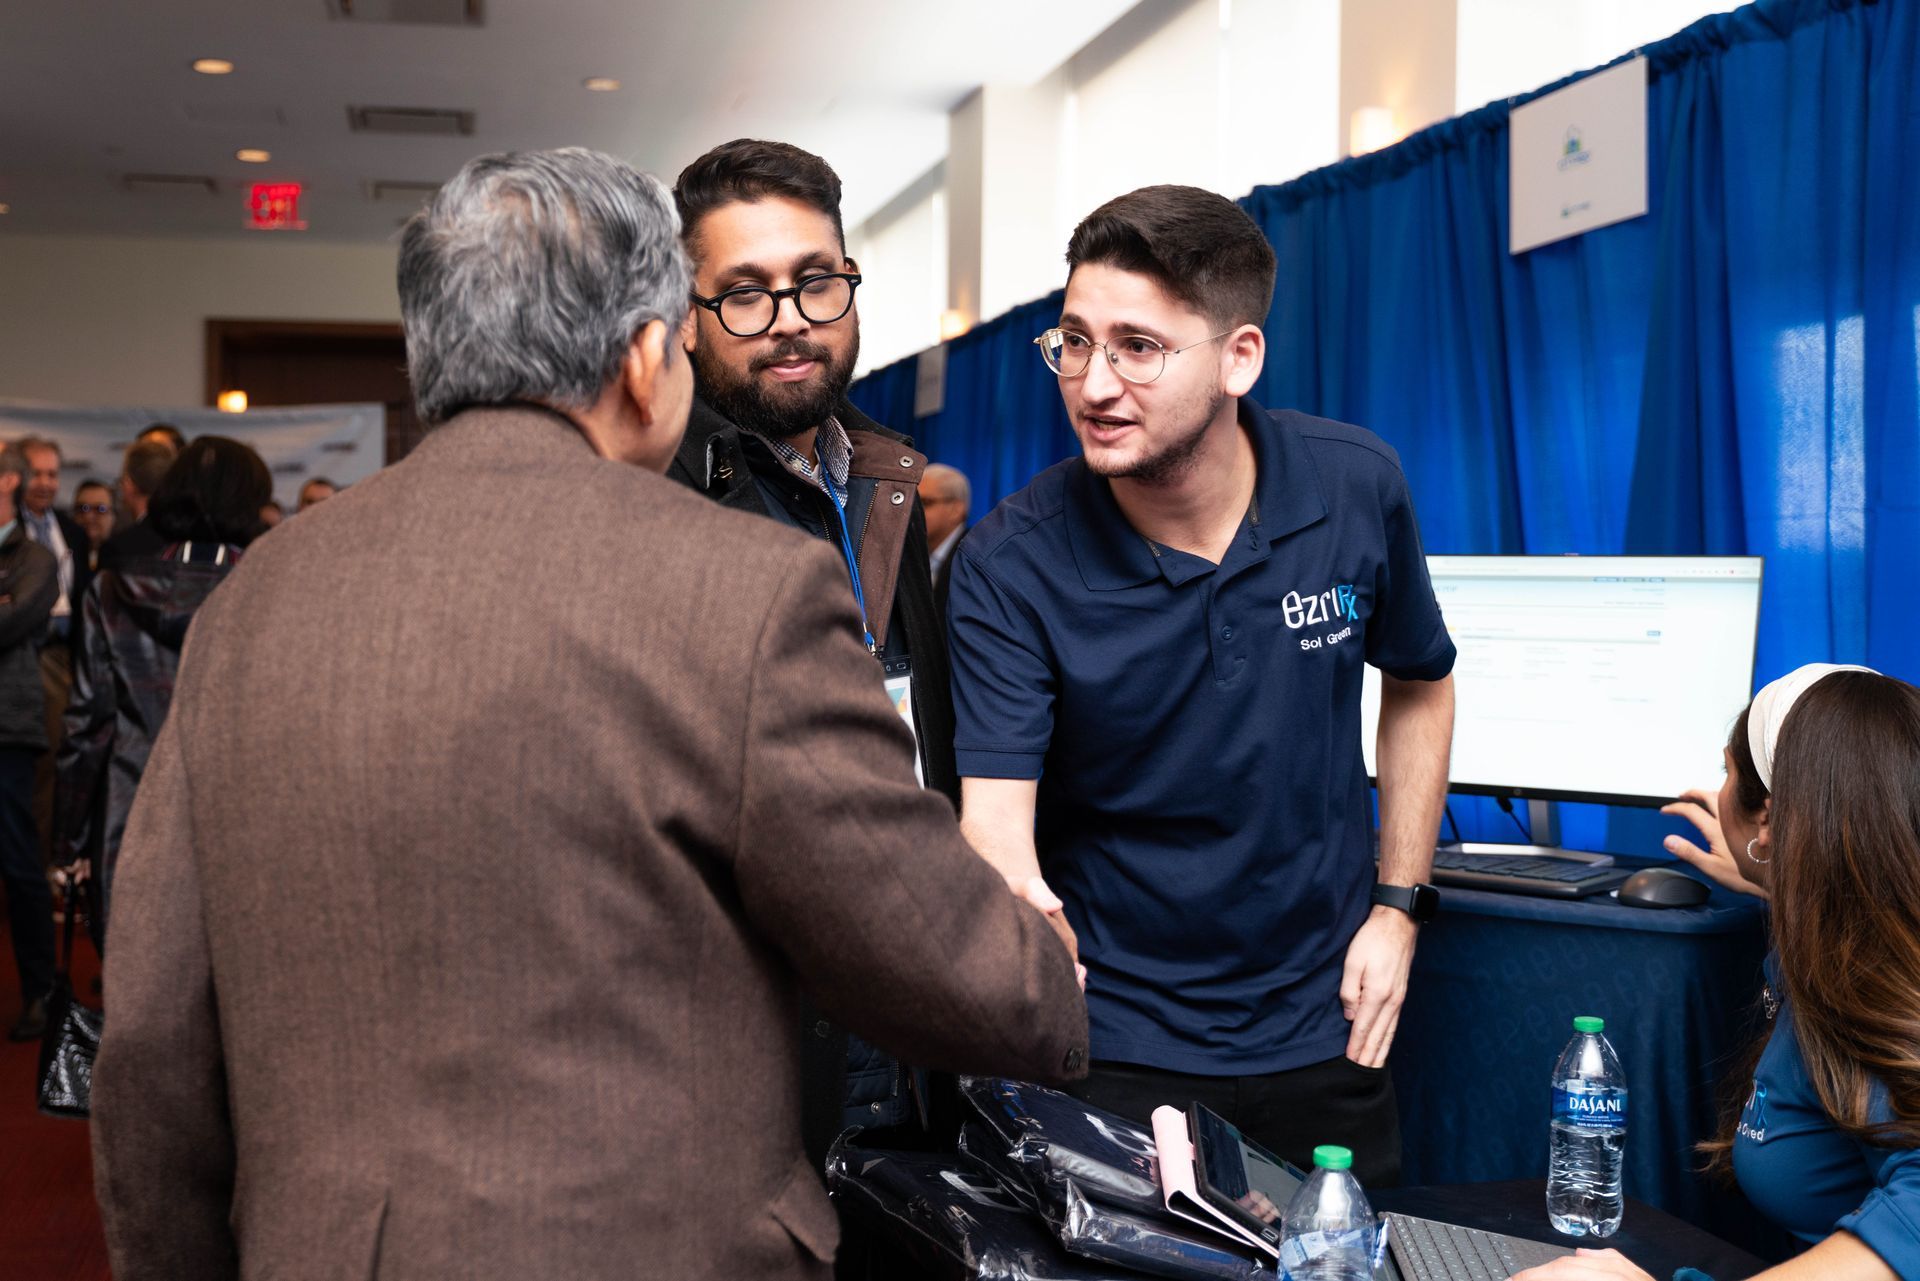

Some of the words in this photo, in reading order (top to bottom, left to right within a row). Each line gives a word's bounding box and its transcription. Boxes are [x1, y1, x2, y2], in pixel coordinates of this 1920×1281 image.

[1300, 637, 1322, 651] Sol
[1327, 626, 1352, 645] Green
[1569, 1096, 1622, 1115] DASANI
